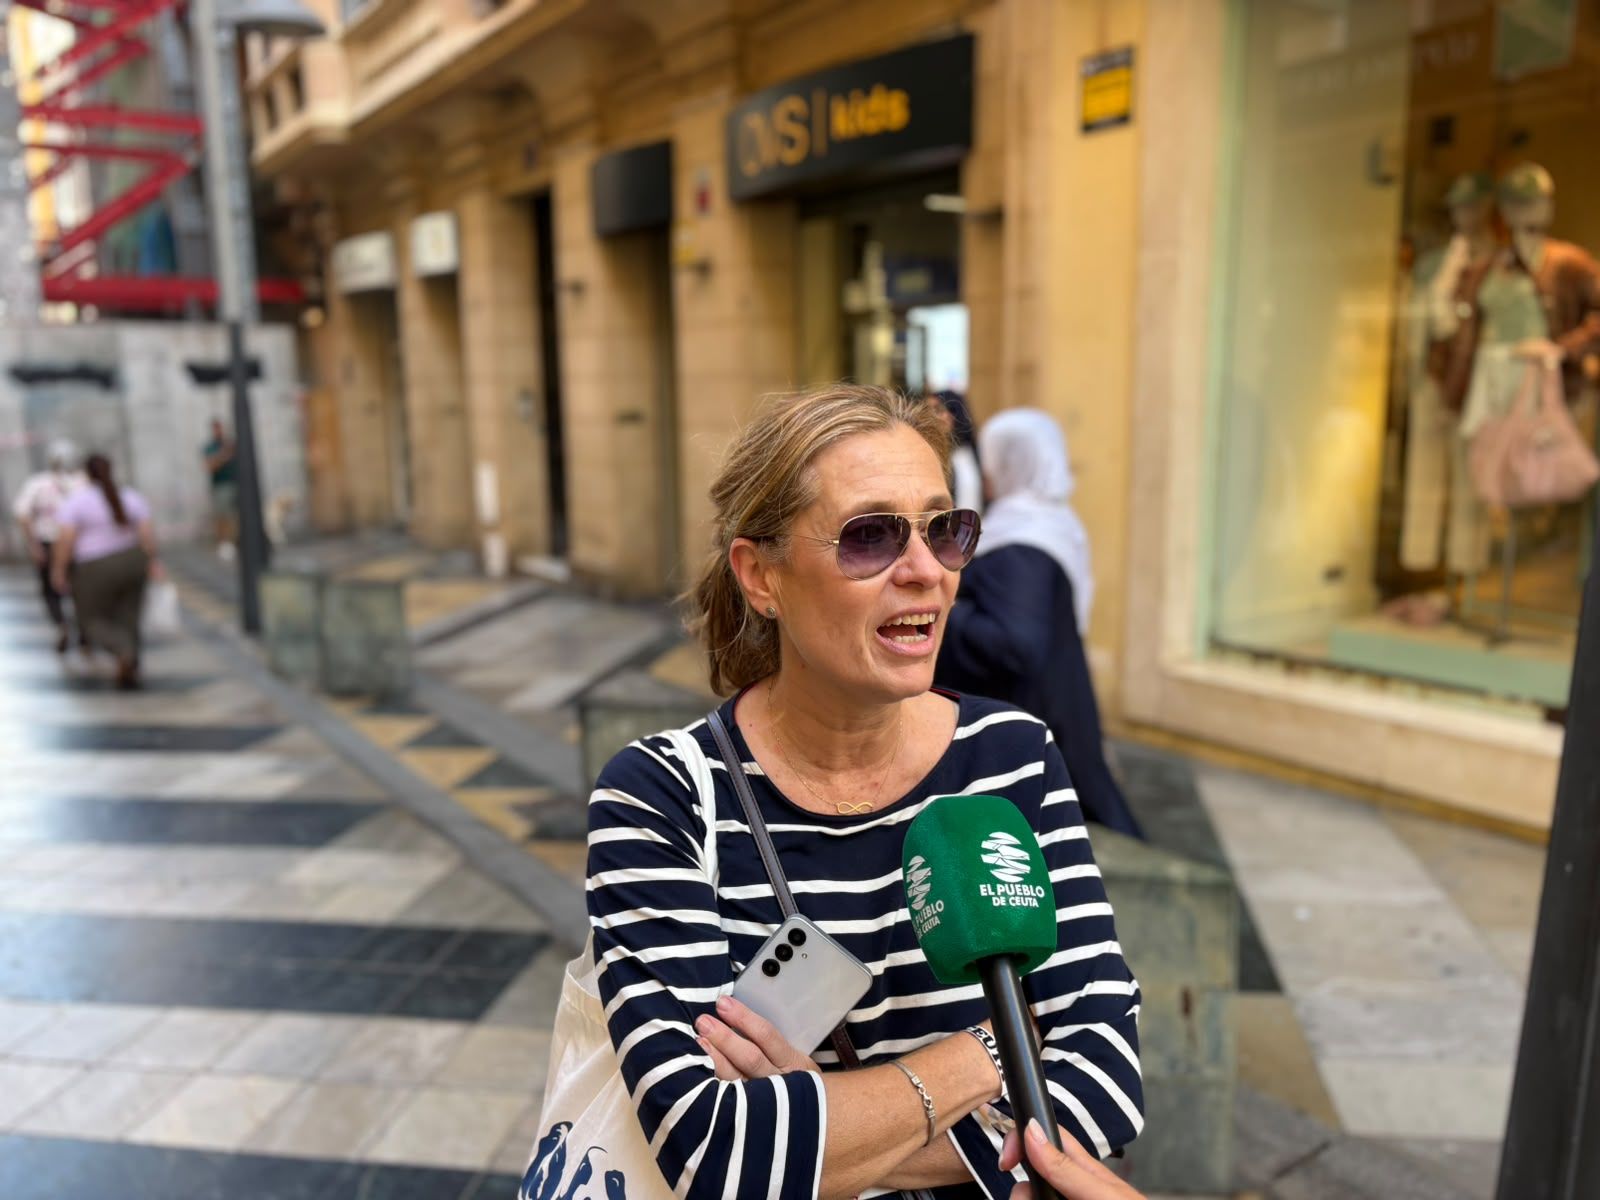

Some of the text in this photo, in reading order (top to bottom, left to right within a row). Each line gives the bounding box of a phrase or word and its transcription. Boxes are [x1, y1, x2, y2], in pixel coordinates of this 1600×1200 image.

[829, 84, 911, 141] kids
[979, 884, 1045, 898] EL PUEBLO
[992, 897, 1039, 908] DE CEUTA
